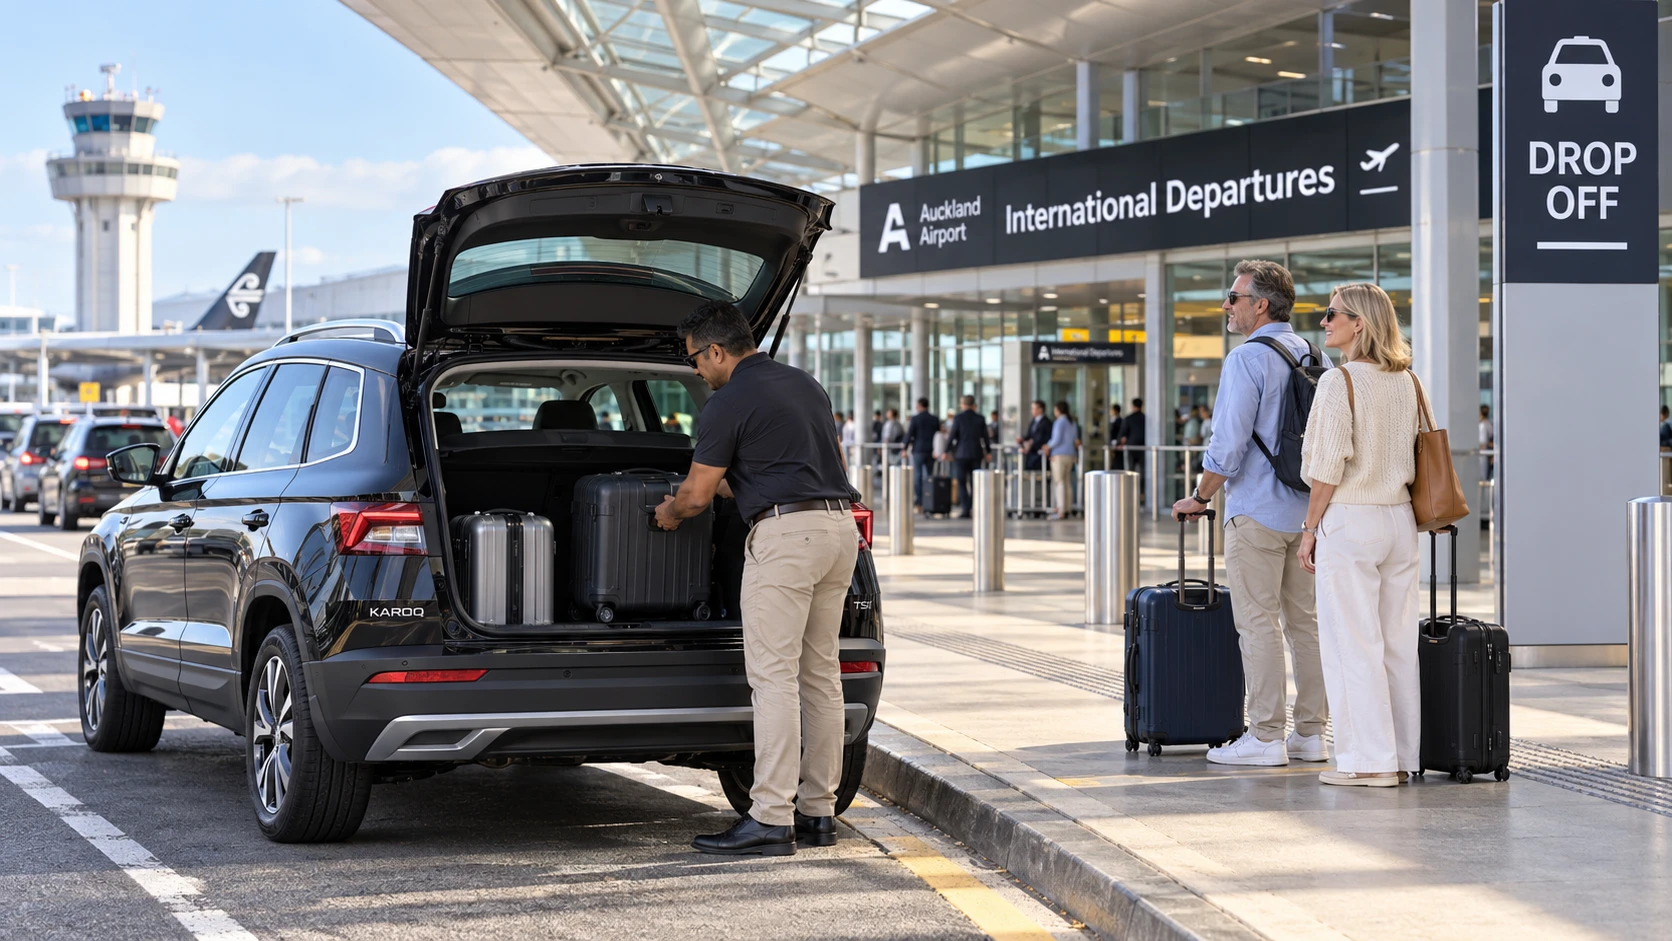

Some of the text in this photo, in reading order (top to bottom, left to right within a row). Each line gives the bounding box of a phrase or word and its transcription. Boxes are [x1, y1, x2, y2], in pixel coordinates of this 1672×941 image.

[1529, 141, 1637, 175] DROP
[919, 196, 981, 224] Auckland
[1005, 165, 1336, 234] International Departures
[1546, 185, 1619, 220] OFF
[919, 222, 968, 249] Airport
[1051, 347, 1088, 357] International
[369, 607, 424, 618] KAROQ
